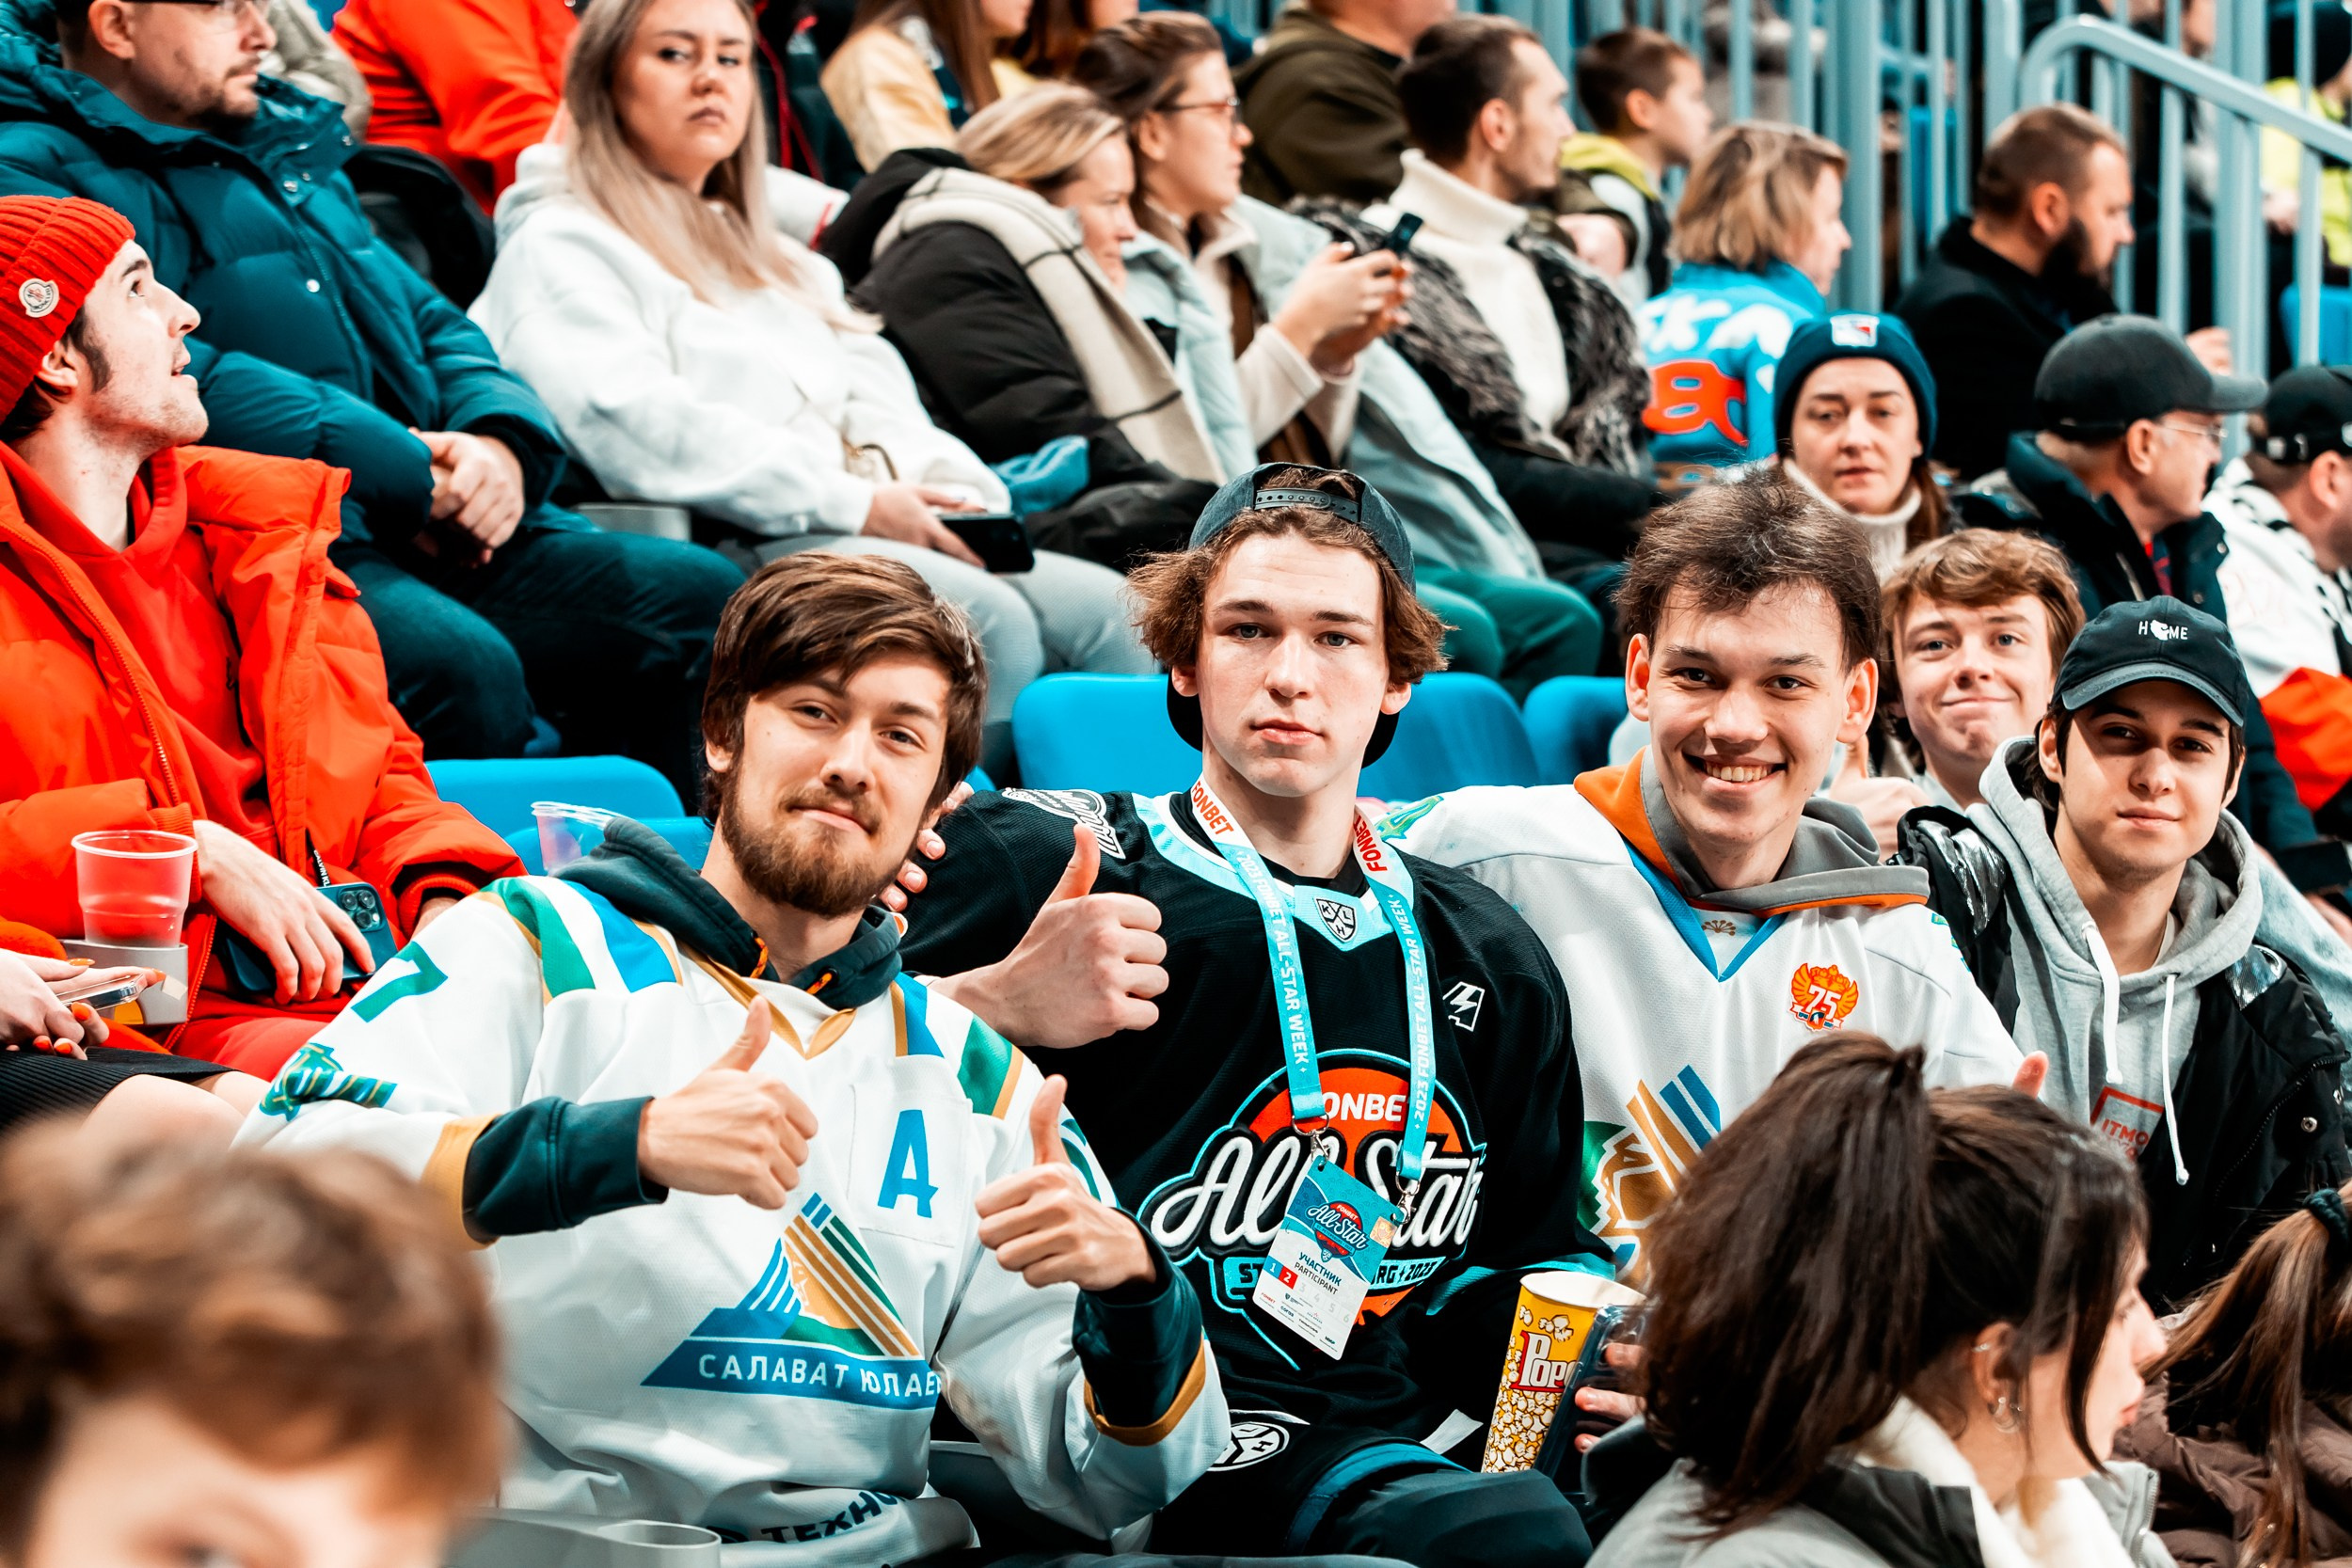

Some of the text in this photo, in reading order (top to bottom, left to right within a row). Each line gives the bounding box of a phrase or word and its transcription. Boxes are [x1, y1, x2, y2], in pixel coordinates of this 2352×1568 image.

[1191, 781, 1234, 835] FONBET
[1353, 815, 1388, 873] FONBET
[313, 849, 328, 877] CALVIN
[1236, 852, 1310, 1065] 2023 FONBET ALL-STAR WEEK
[350, 941, 449, 1023] 7
[1388, 899, 1430, 1121] 2023 FONBET ALL-STAR WEEK
[1805, 984, 1842, 1020] 75
[1319, 1091, 1406, 1122] ONBE
[2101, 1118, 2149, 1146] ITMO
[877, 1109, 939, 1218] A
[1336, 1204, 1359, 1221] FONBET
[1269, 1262, 1276, 1273] 1
[1283, 1272, 1293, 1283] 2
[1294, 1261, 1338, 1295] PARTICIPANT
[1298, 1252, 1343, 1287] УЧАСТНИК
[699, 1354, 849, 1389] САЛАВАТ
